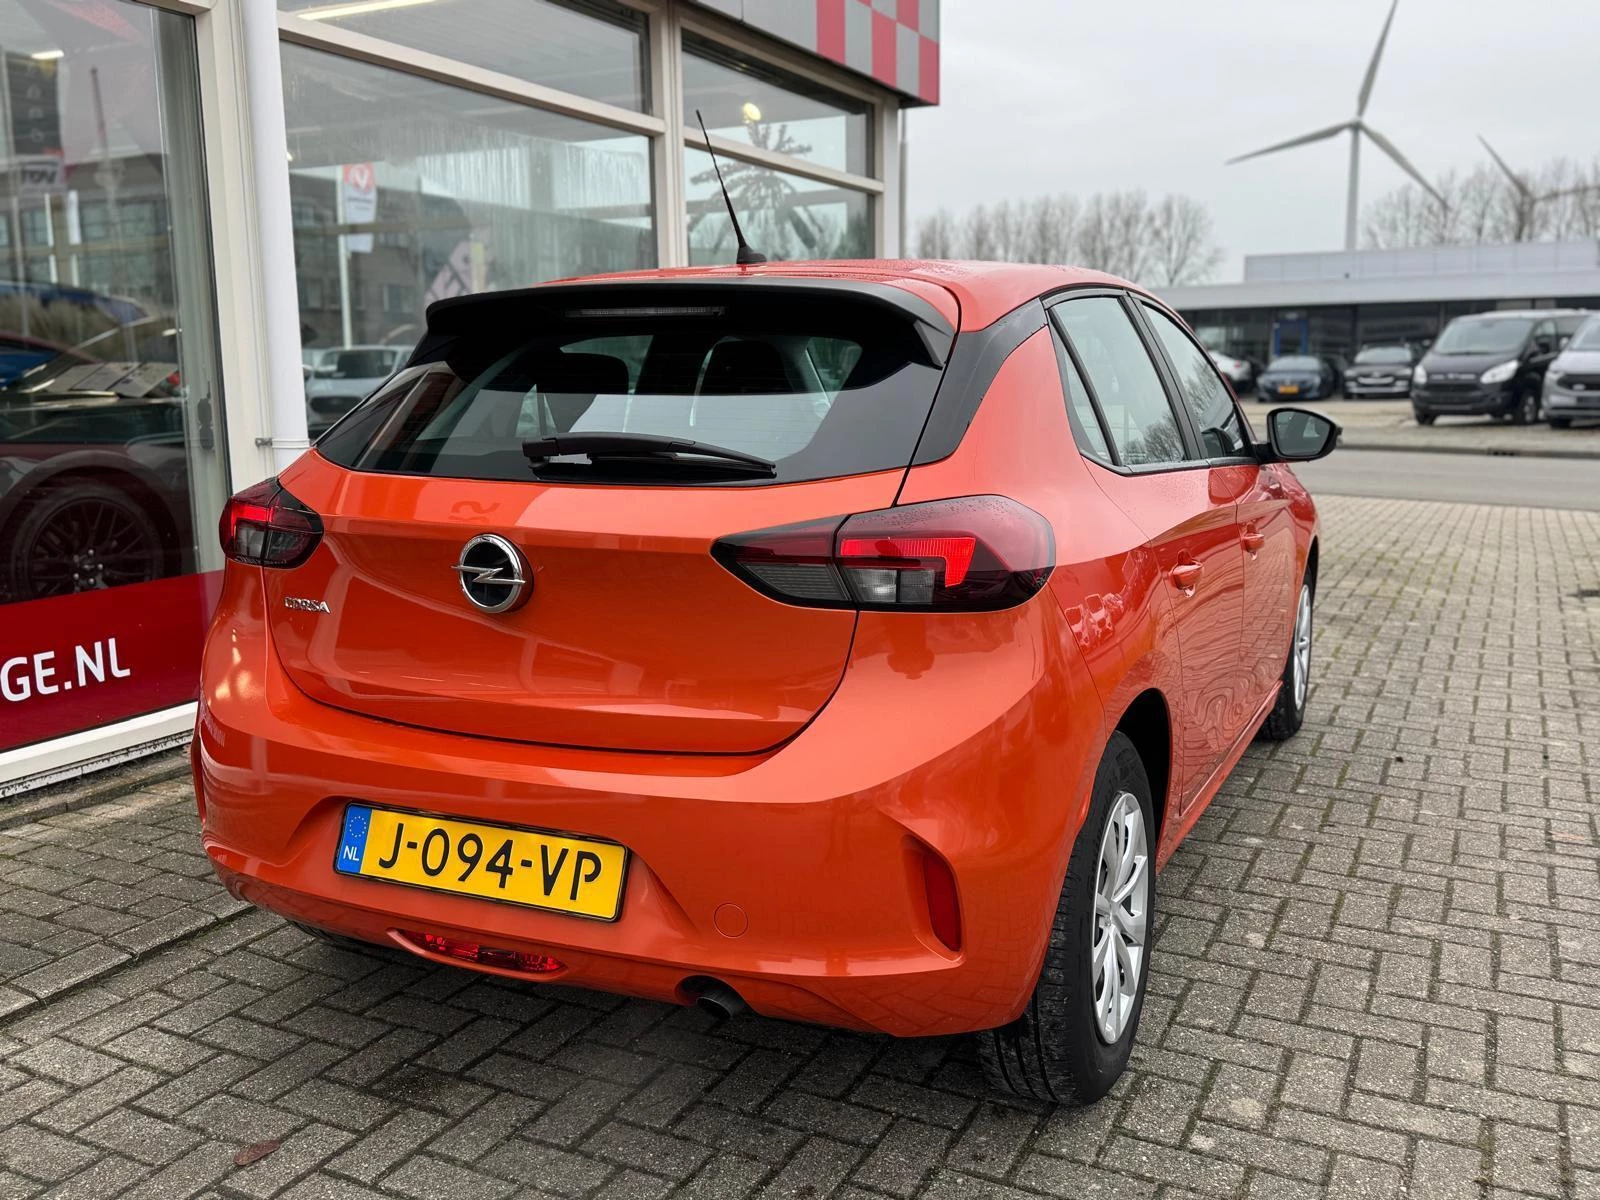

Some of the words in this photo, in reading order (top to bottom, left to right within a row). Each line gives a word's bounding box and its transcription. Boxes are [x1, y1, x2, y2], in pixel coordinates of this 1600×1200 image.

[284, 596, 331, 614] CORSA
[0, 637, 131, 702] GE.NL
[343, 845, 360, 862] NL
[378, 822, 602, 901] J-094-VP
